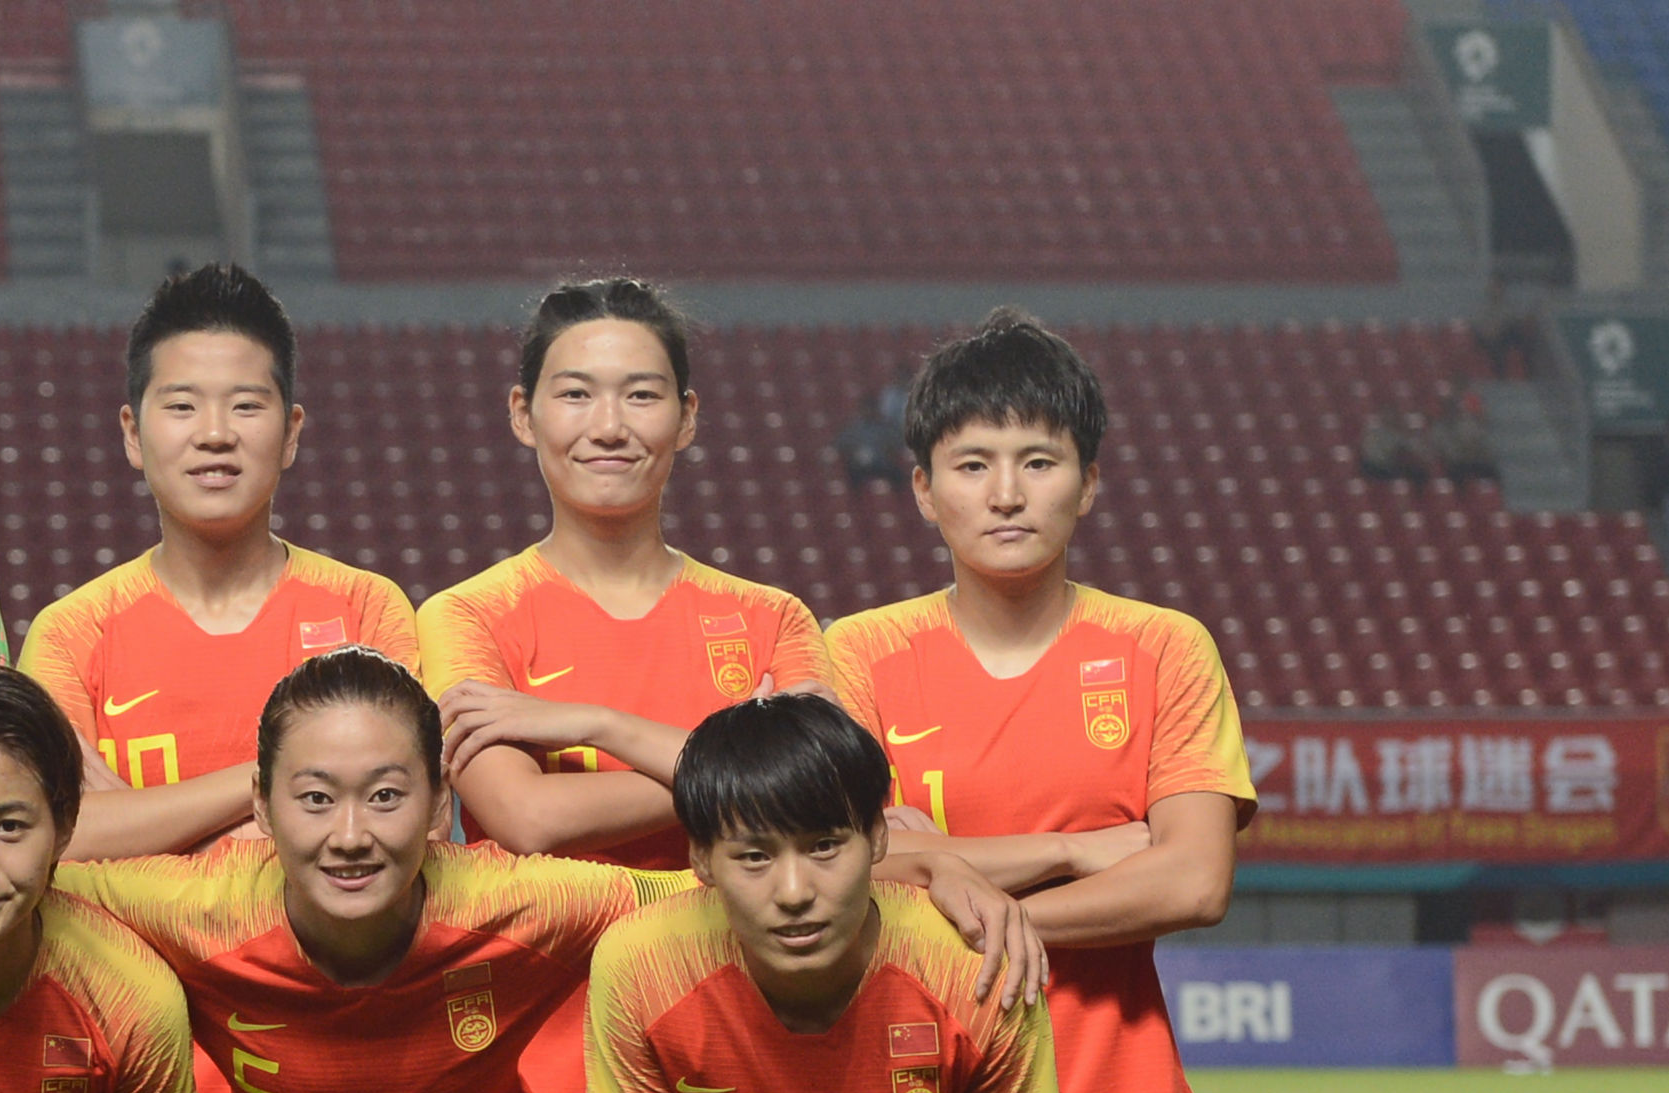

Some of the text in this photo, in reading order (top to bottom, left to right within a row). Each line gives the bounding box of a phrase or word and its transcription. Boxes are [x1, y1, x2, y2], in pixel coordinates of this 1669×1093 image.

[711, 643, 748, 656] CFA
[1086, 693, 1123, 707] CFA
[452, 994, 489, 1013] CFA
[1178, 982, 1293, 1044] BRI
[1477, 973, 1669, 1076] QAT
[896, 1068, 934, 1084] CFA
